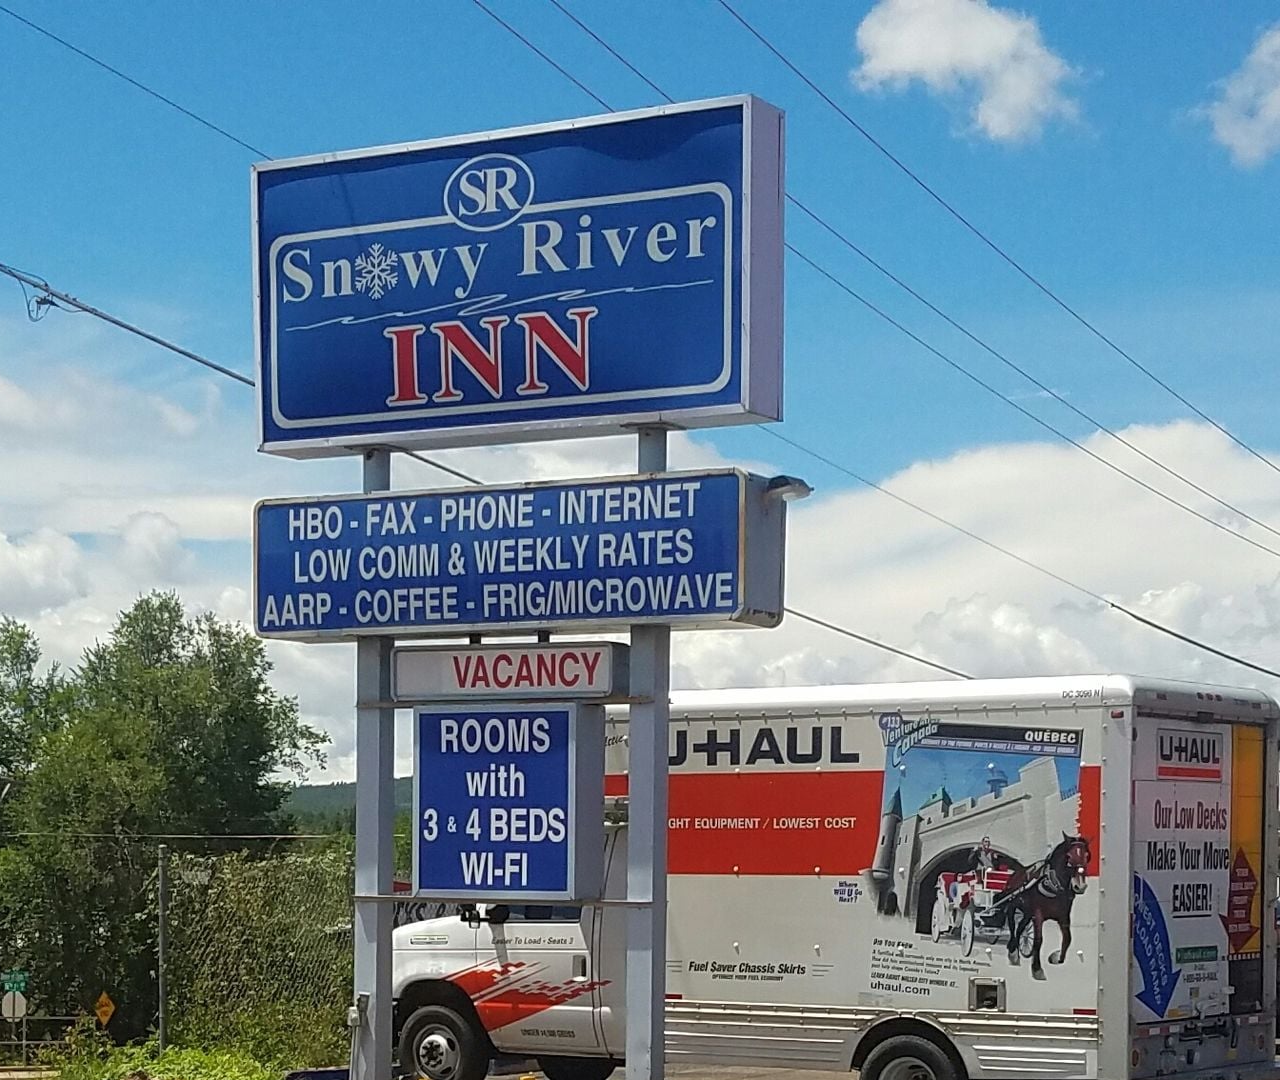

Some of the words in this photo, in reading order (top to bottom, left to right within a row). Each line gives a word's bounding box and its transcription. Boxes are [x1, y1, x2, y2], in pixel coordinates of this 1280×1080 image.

[457, 167, 522, 218] SR
[517, 213, 717, 277] River
[383, 307, 599, 409] INN
[289, 507, 343, 542] HBO
[366, 502, 417, 537] FAX
[440, 494, 534, 532] PHONE
[559, 482, 701, 526] INTERNET
[294, 549, 352, 584] LOW
[359, 542, 440, 581] COMM
[448, 542, 466, 575] &
[475, 534, 591, 574] WEEKLY
[598, 528, 694, 568] RATES
[263, 593, 332, 628] AARP
[355, 585, 459, 623] COFFEE
[483, 572, 734, 618] FRIG/MICROWAVE
[453, 651, 601, 688] VACANCY
[440, 717, 551, 754] ROOMS
[893, 724, 939, 768] Canada
[1025, 730, 1077, 743] QUÉBEC
[1159, 735, 1220, 765] U-HAUL
[466, 764, 526, 797] with
[423, 808, 438, 841] 3
[447, 815, 457, 833] &
[465, 807, 482, 842] 4
[490, 806, 566, 842] BEDS
[668, 818, 691, 829] GHT
[694, 818, 761, 829] EQUIPMENT
[773, 818, 821, 829] LOWEST
[824, 817, 857, 829] COST
[1154, 799, 1171, 829] Our
[1174, 800, 1194, 829] Low
[1197, 801, 1228, 830] Decks
[461, 851, 529, 887] WI-FI
[1147, 841, 1176, 871] Make
[1179, 841, 1201, 870] Your
[1203, 841, 1229, 870] Move
[1172, 883, 1213, 913] EASIER!
[688, 961, 708, 972] Fuel
[738, 962, 775, 974] Chassis
[777, 963, 806, 975] Skirts
[870, 980, 930, 996] uhaul.com
